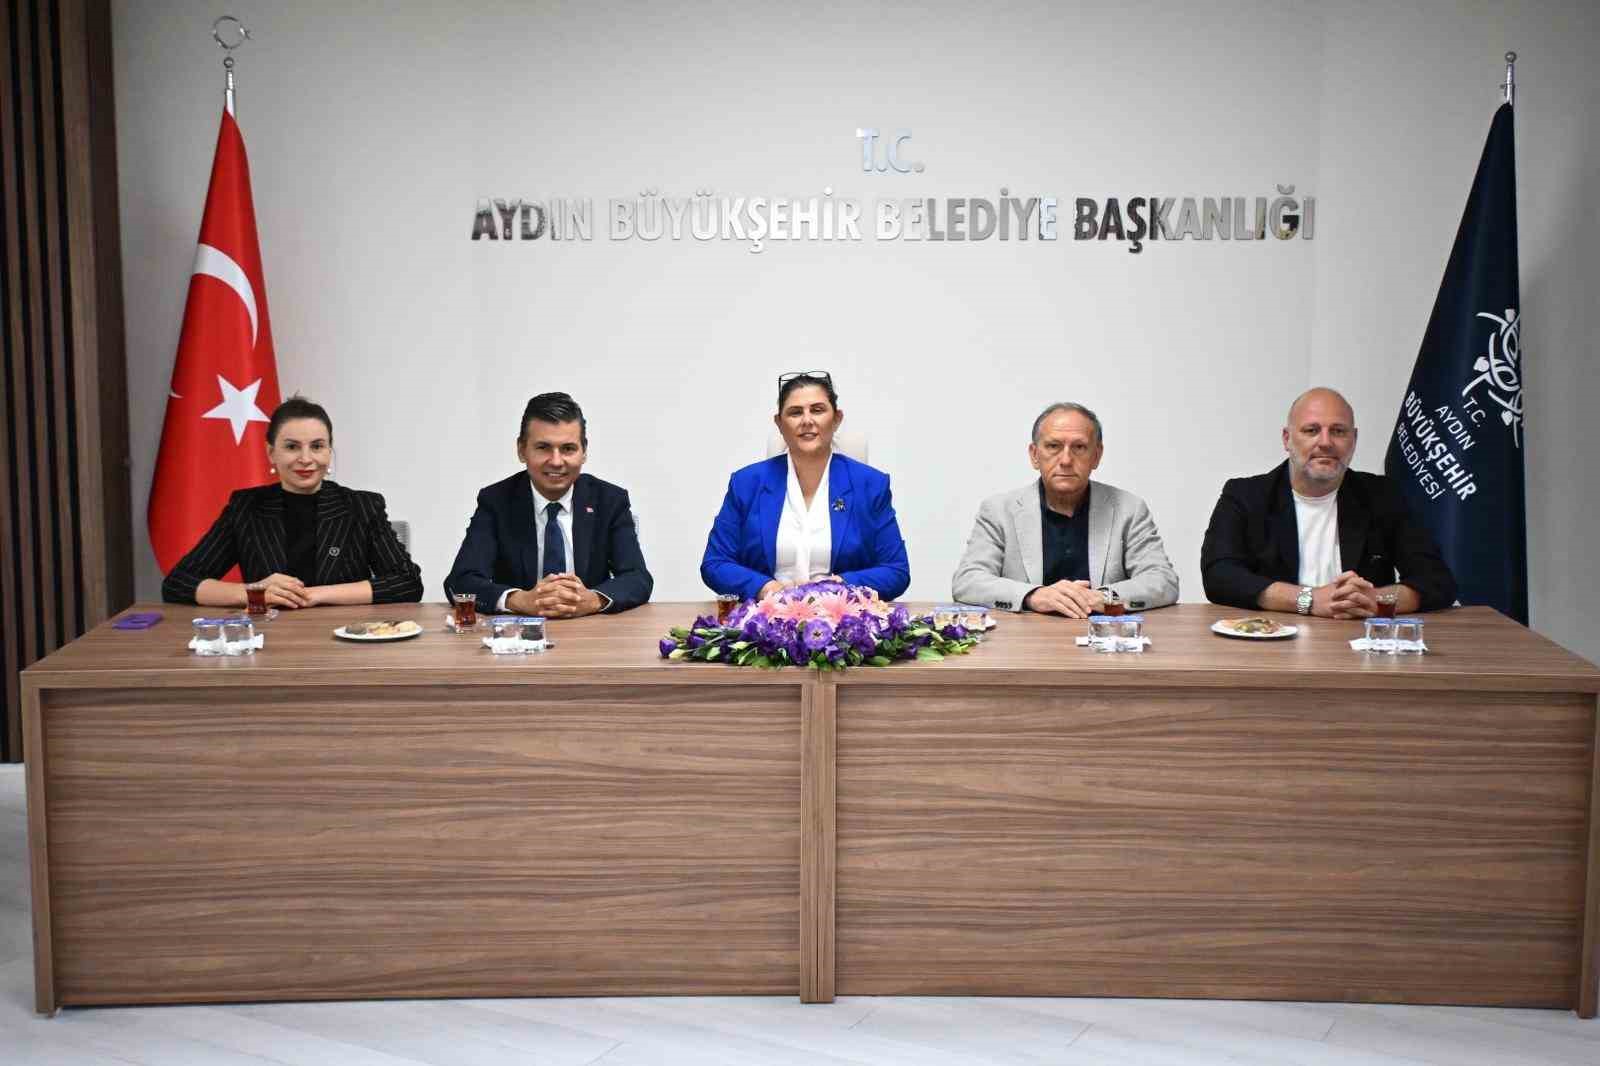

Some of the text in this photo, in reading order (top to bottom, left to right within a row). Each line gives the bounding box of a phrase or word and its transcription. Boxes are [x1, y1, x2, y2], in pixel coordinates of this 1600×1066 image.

[855, 128, 924, 173] T.C.
[471, 184, 1316, 254] AYDIN BÜYÜKŞEHİR BELEDİYE BAŞKANLIĞI
[1435, 405, 1476, 451] AYDIN
[1463, 397, 1486, 428] T.C.
[1405, 391, 1477, 501] BÜYÜKŞEHİR
